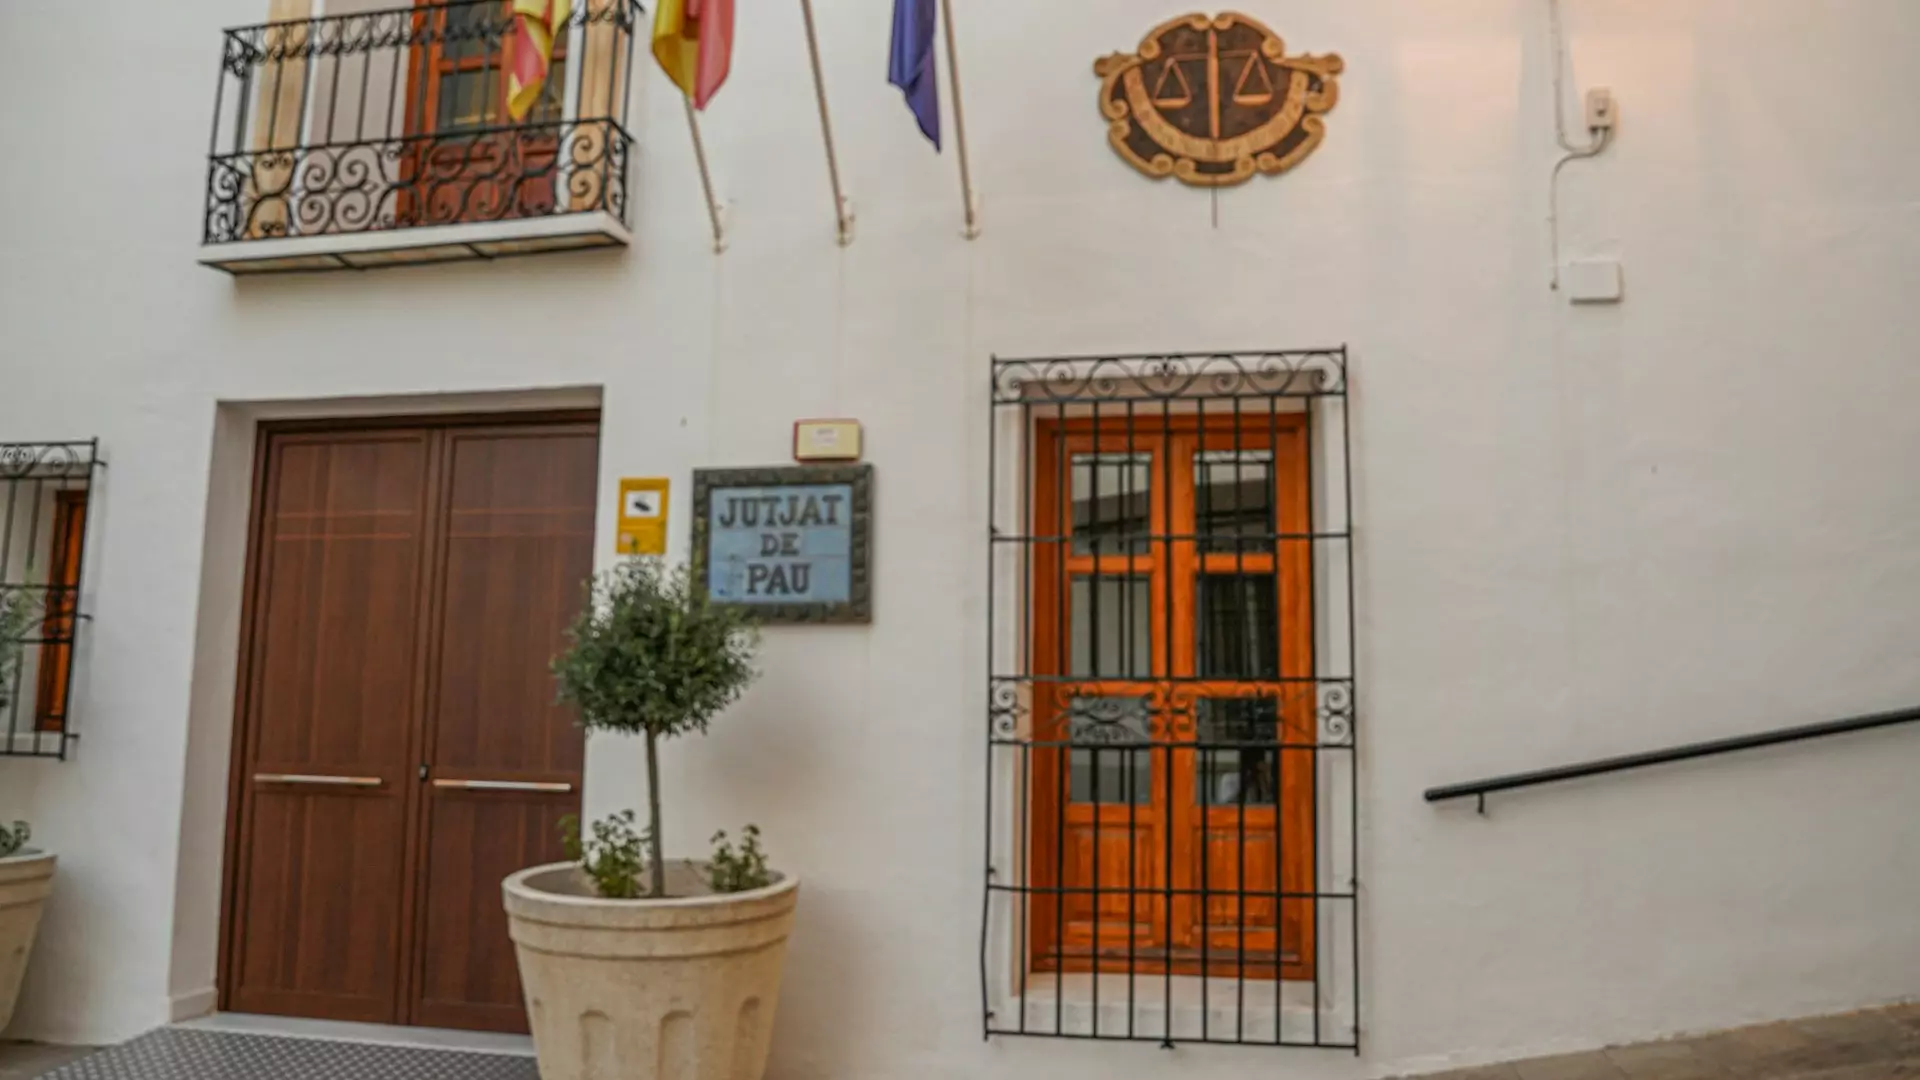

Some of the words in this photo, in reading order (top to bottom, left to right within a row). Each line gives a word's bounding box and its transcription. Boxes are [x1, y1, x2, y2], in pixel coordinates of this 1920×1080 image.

[719, 494, 844, 527] JUTJAT
[760, 533, 799, 557] DE
[746, 563, 812, 595] PAU
